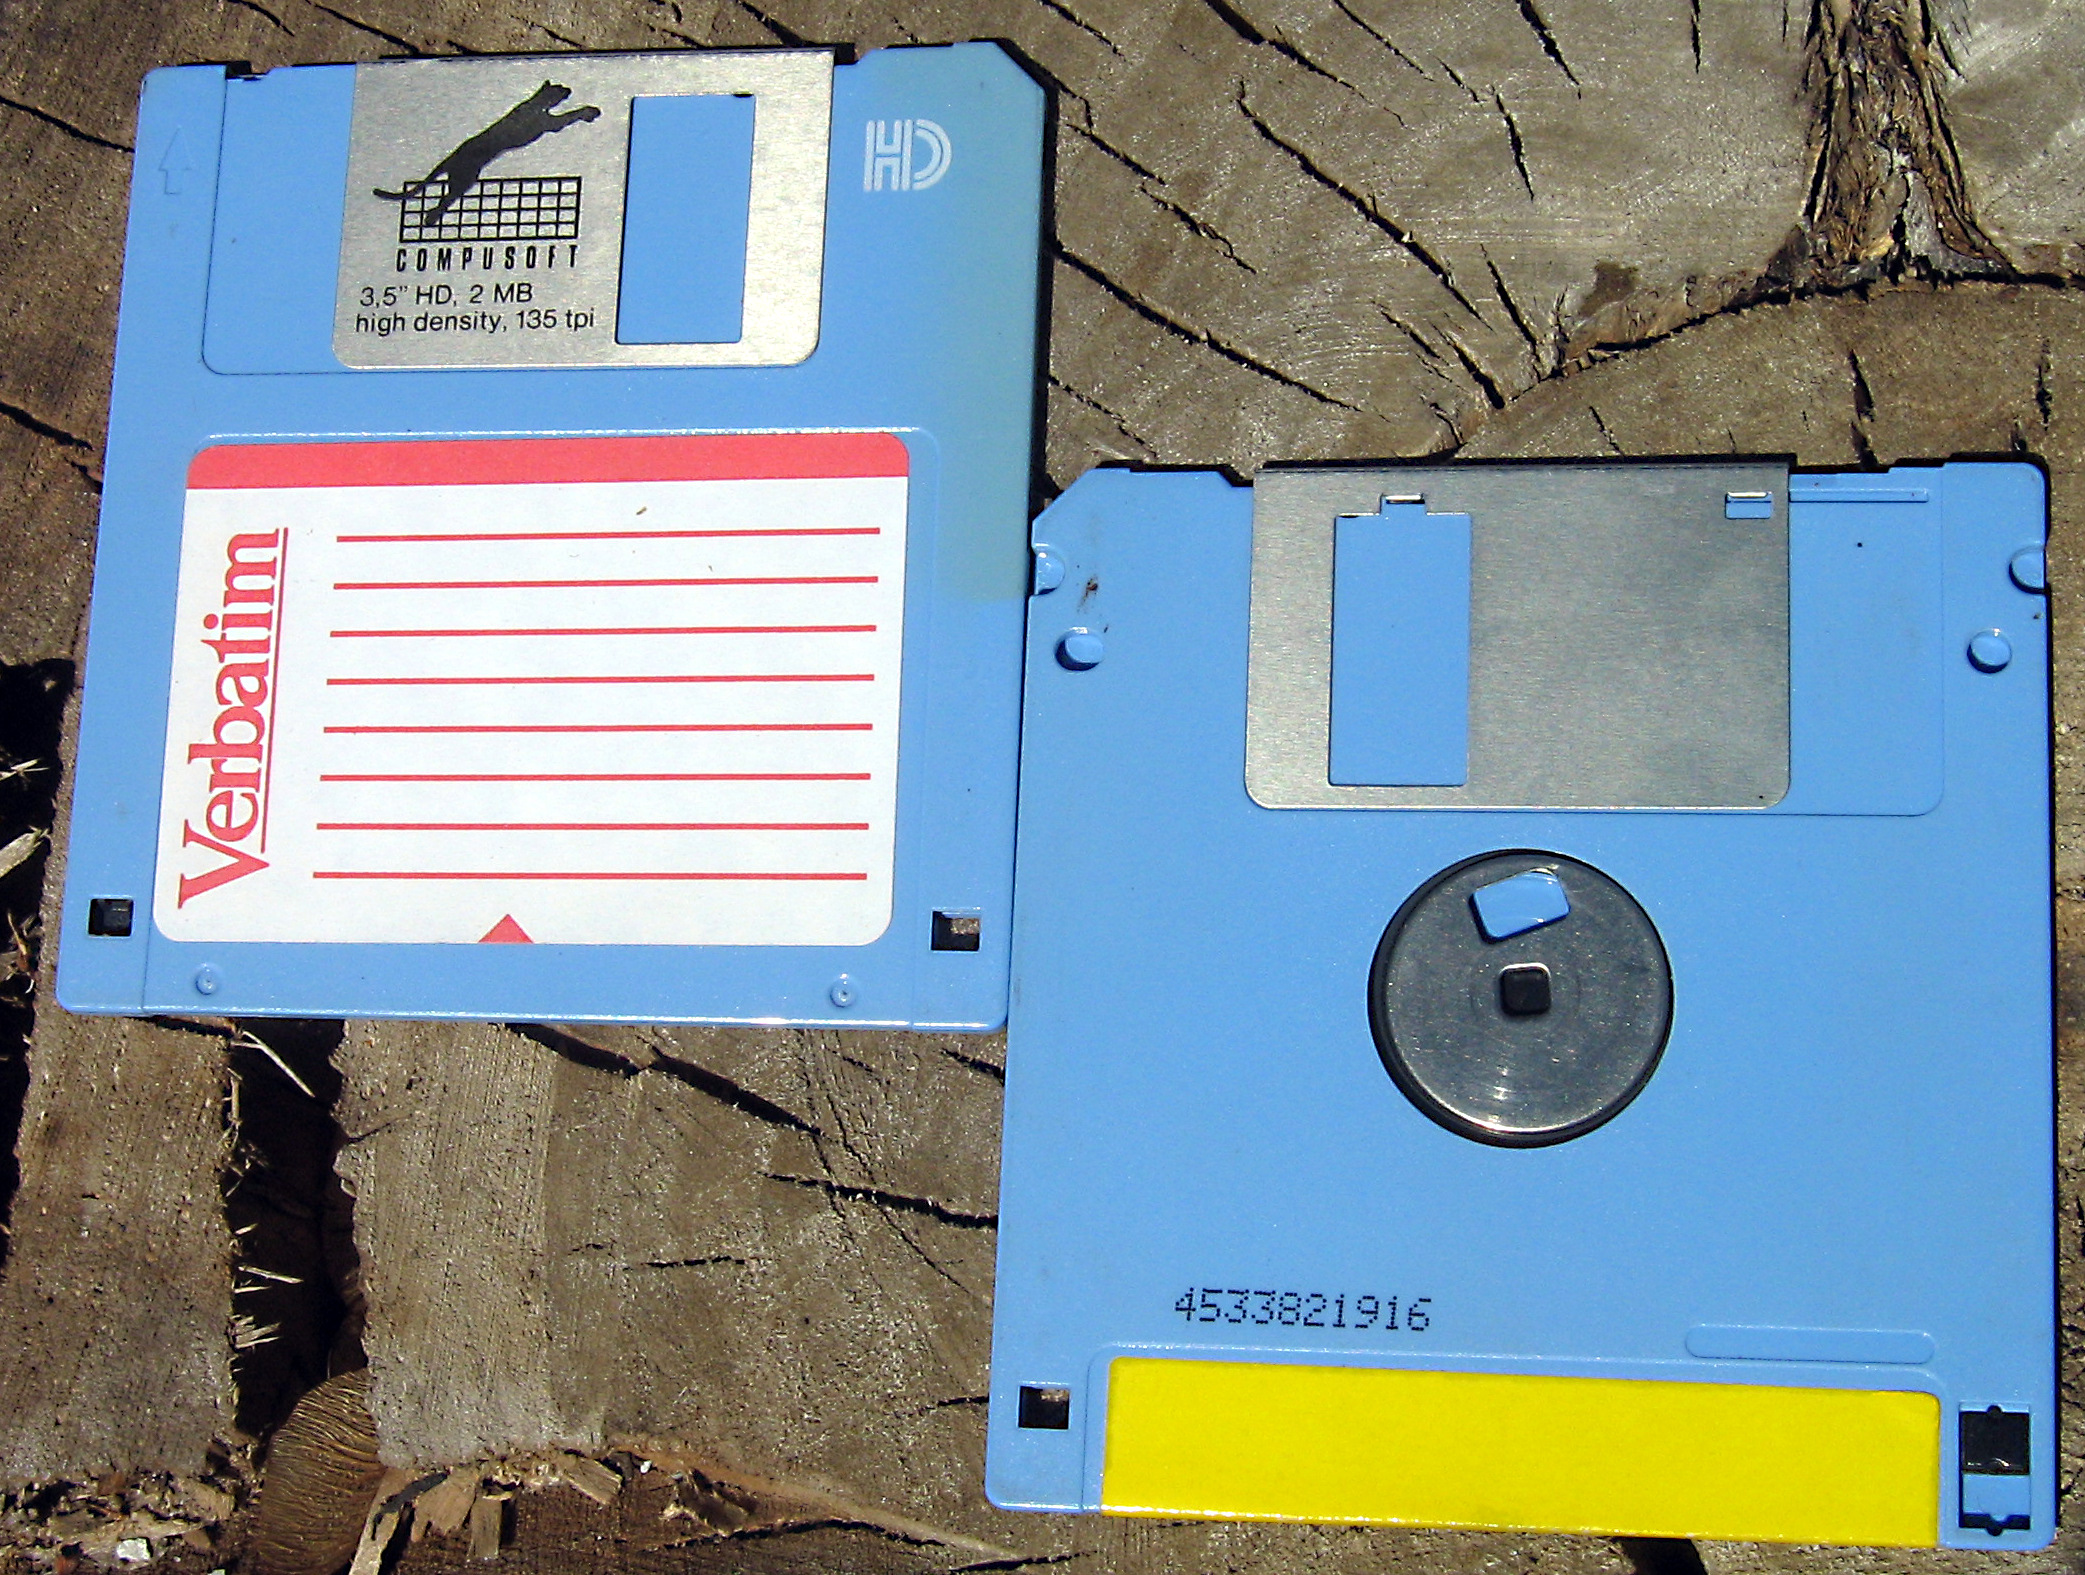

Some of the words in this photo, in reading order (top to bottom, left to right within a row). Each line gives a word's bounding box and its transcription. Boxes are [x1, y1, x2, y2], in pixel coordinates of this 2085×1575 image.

[863, 119, 952, 192] HD
[396, 244, 579, 272] COMPUSOFT
[415, 285, 457, 307] HD,
[469, 284, 484, 304] 2
[493, 282, 533, 304] MB
[355, 312, 406, 337] high
[413, 310, 507, 333] density,
[516, 308, 558, 330] 135
[565, 307, 595, 332] tpi
[178, 528, 280, 909] Verbatim
[1175, 1287, 1432, 1331] 4533821916
